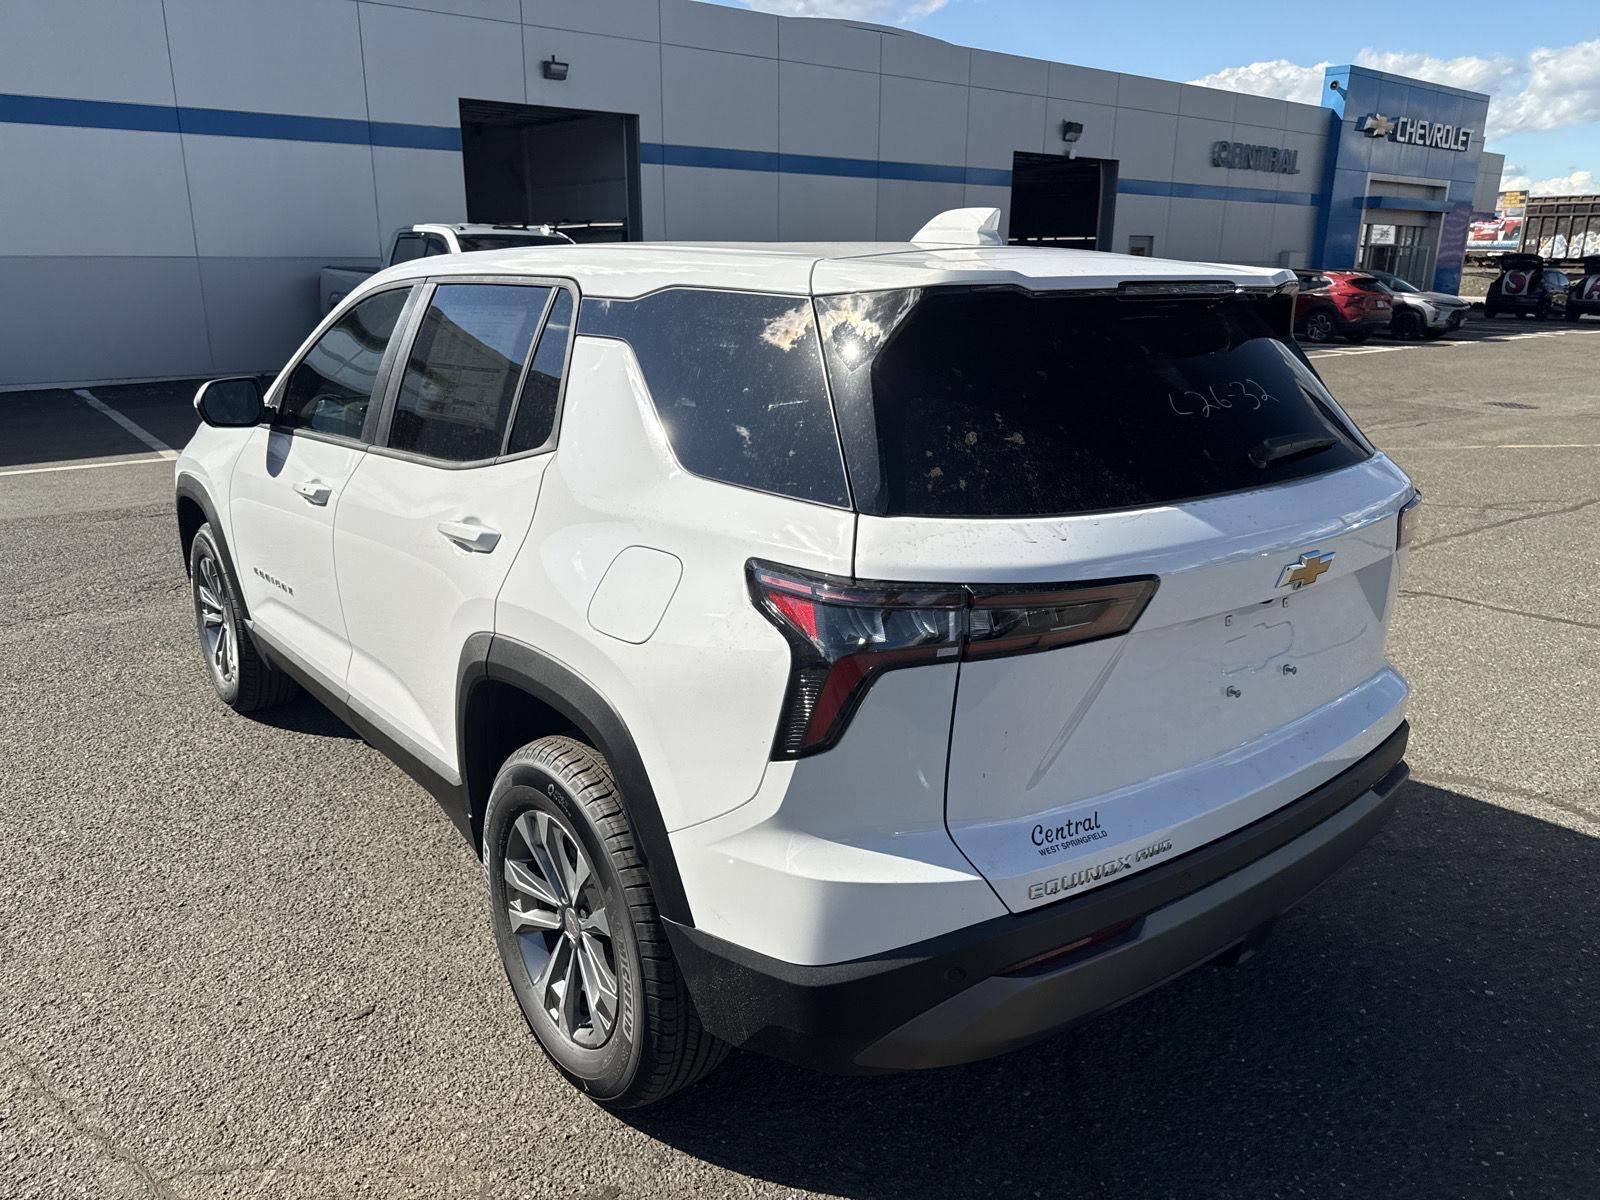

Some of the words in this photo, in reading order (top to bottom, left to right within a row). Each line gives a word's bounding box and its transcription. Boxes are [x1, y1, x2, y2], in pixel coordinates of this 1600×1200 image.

[1396, 117, 1475, 151] CHEVROLET
[1212, 141, 1301, 175] CENTRAL
[1031, 811, 1101, 846] Central
[1038, 844, 1060, 857] WEST
[1062, 830, 1108, 850] SPRINGFIELD
[1029, 854, 1132, 900] EQUINOX
[617, 941, 634, 1037] MICHELIN
